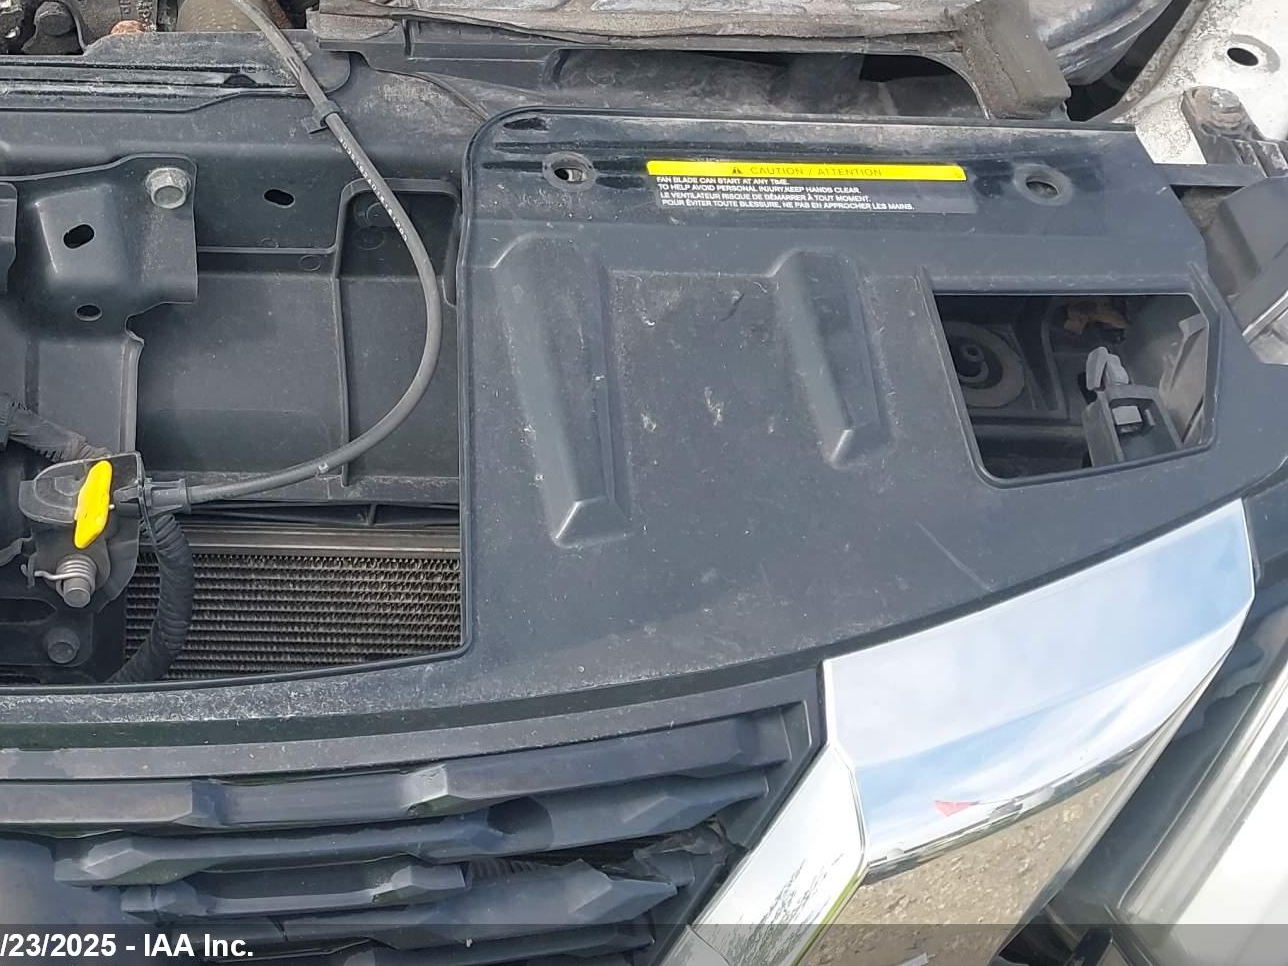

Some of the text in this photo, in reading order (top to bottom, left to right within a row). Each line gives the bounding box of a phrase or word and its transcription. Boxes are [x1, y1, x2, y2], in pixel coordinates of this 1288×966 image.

[750, 167, 804, 176] CAUTION
[817, 168, 883, 177] ATTENTION
[656, 176, 672, 184] FAN
[699, 177, 717, 185] CAN
[685, 199, 712, 207] ÉVITER
